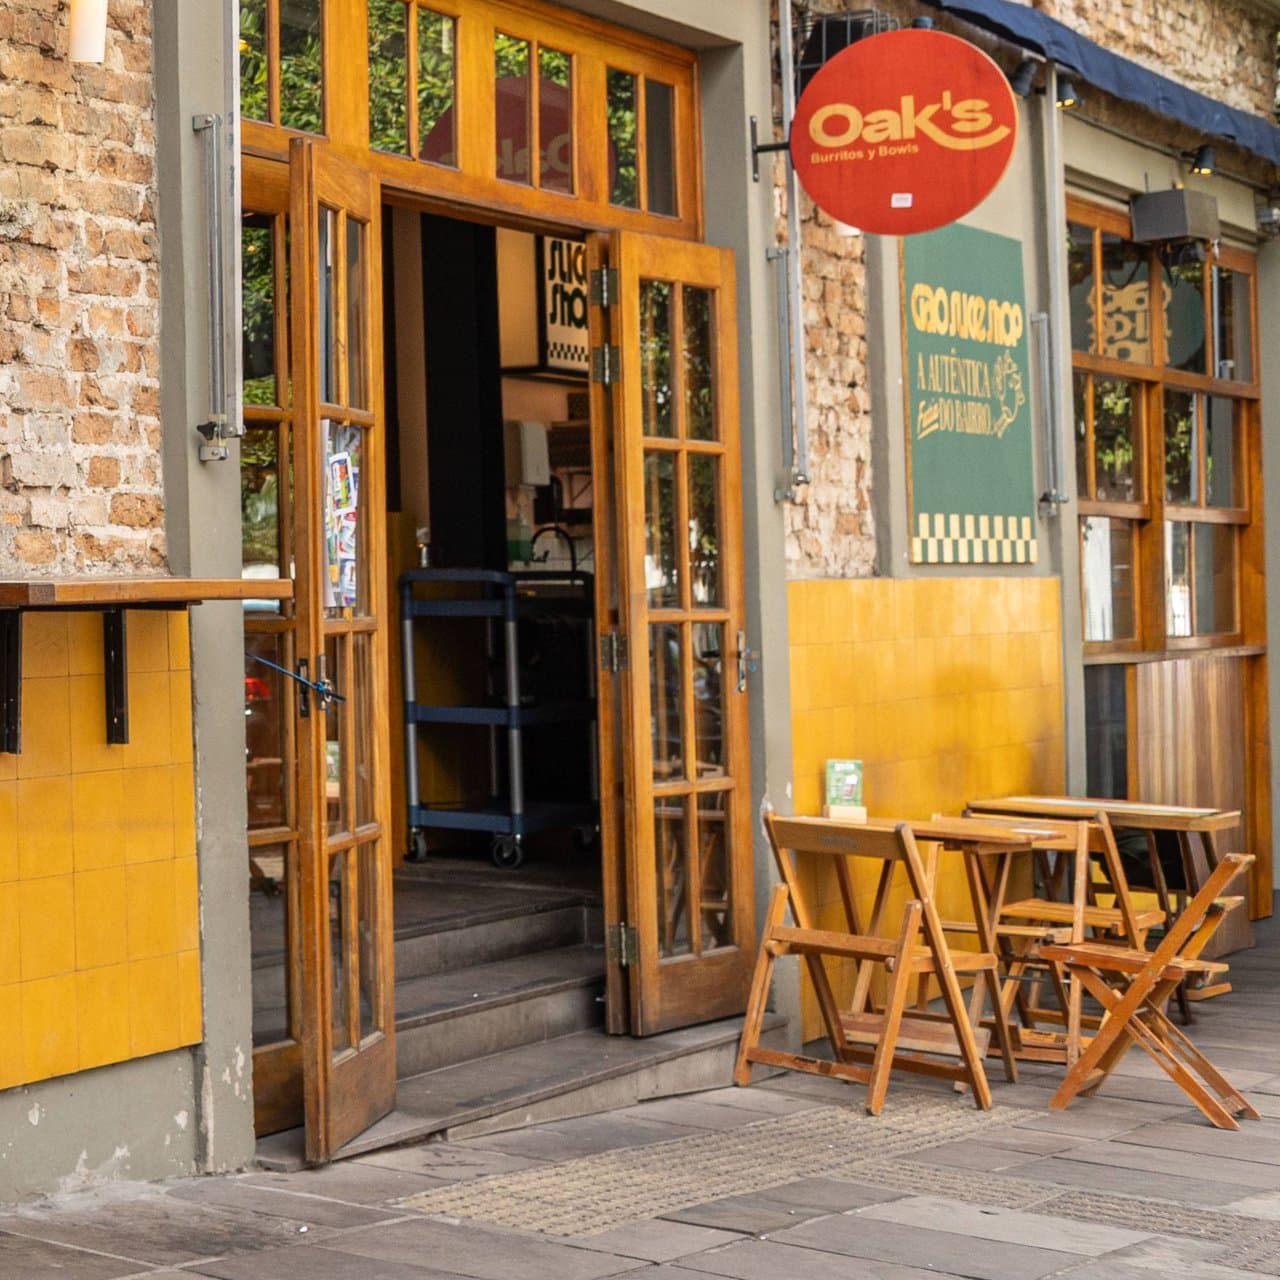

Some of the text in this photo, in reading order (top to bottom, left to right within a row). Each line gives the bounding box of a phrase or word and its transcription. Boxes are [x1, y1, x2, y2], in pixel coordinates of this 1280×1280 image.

[809, 90, 1011, 151] Oak's
[811, 144, 919, 164] Burritos y Bowls
[917, 347, 992, 399] A AUTÊNTICA
